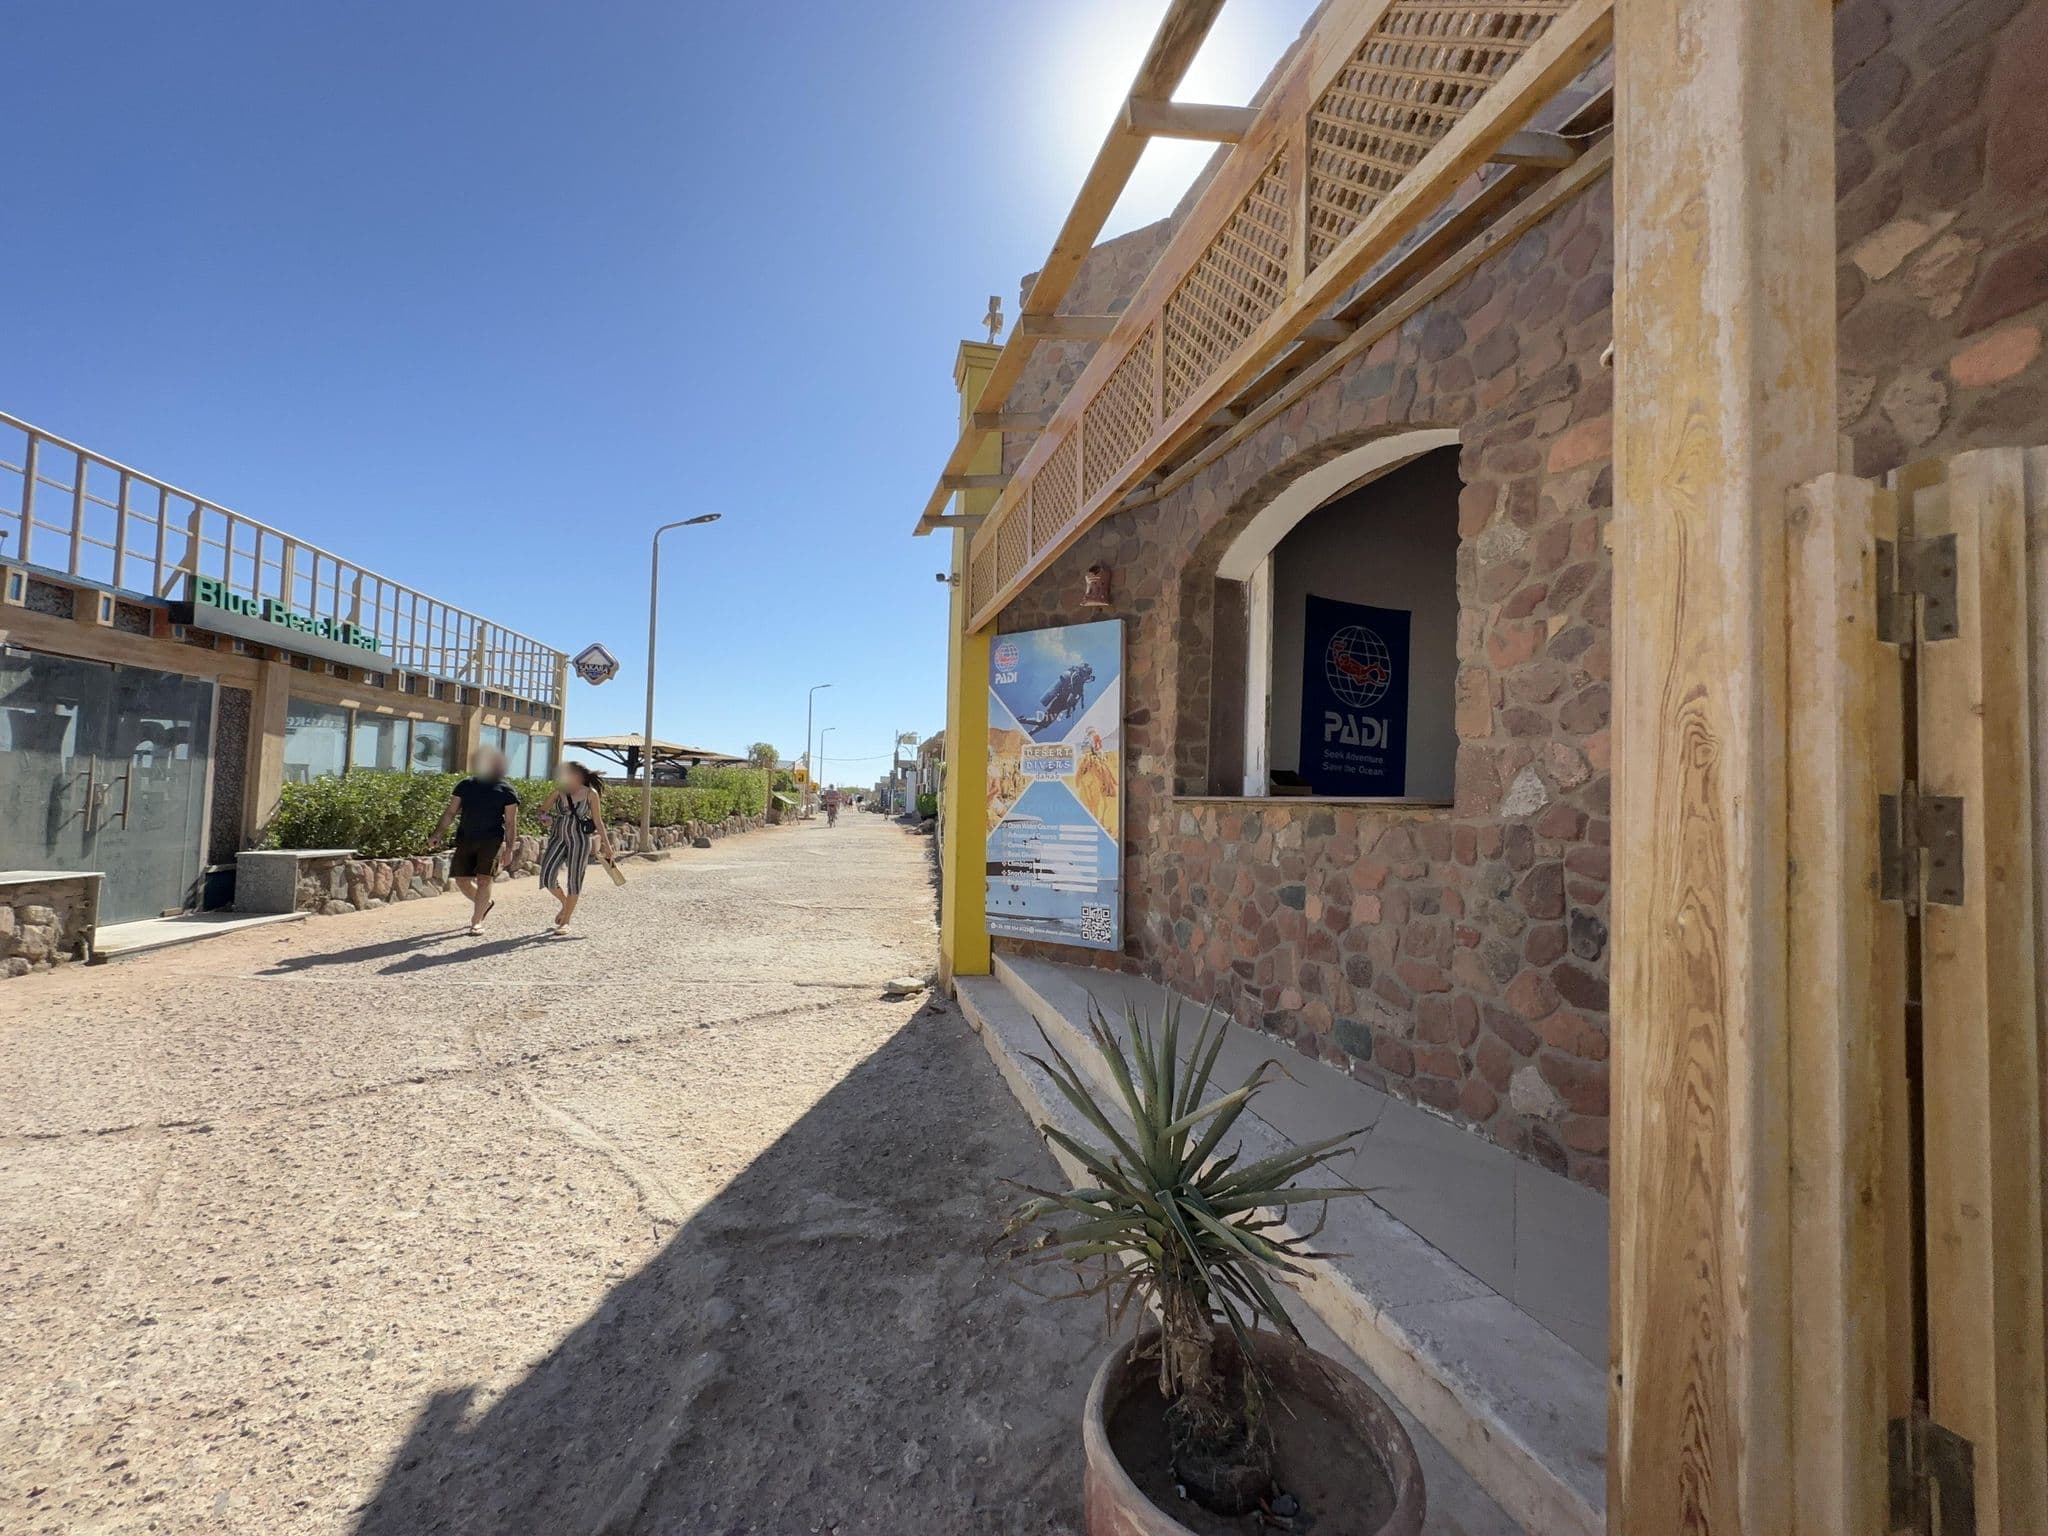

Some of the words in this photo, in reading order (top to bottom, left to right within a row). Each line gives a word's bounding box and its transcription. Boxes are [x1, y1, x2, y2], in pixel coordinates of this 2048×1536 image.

[197, 575, 260, 619] Blue
[266, 599, 343, 642] Beach
[347, 624, 381, 653] Bar
[995, 671, 1018, 685] PADI
[1036, 710, 1064, 723] Dive
[1324, 711, 1388, 749] PADI
[1026, 748, 1070, 758] DESERT
[1323, 748, 1345, 759] Seek
[1026, 760, 1070, 770] DIVERS
